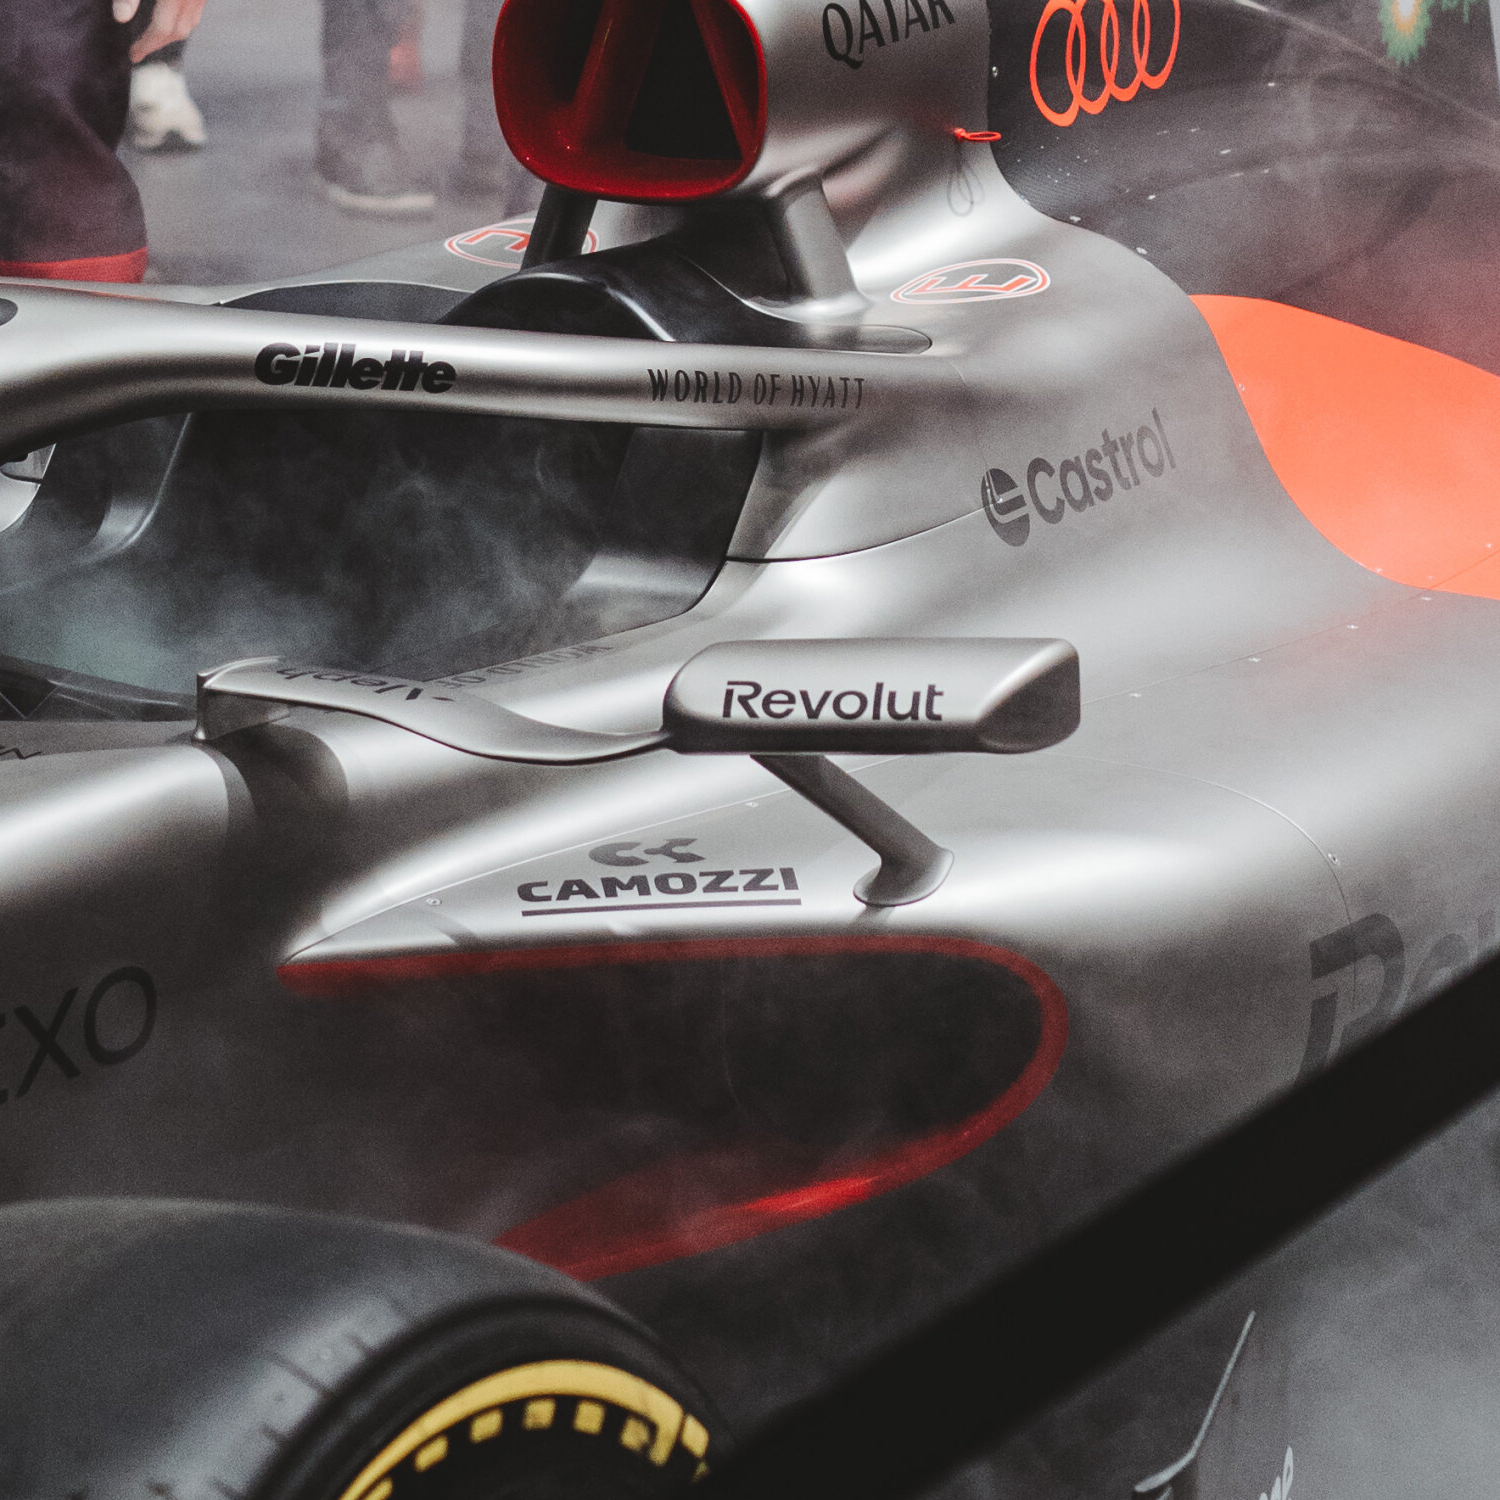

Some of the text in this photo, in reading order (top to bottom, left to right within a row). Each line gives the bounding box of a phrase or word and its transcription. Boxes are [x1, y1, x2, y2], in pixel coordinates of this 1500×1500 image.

[254, 342, 456, 393] Gillette
[647, 368, 866, 409] WORLD OF HYATT
[1028, 407, 1177, 525] Castrol
[722, 680, 944, 721] Revolut
[517, 867, 800, 903] CAMOZZI
